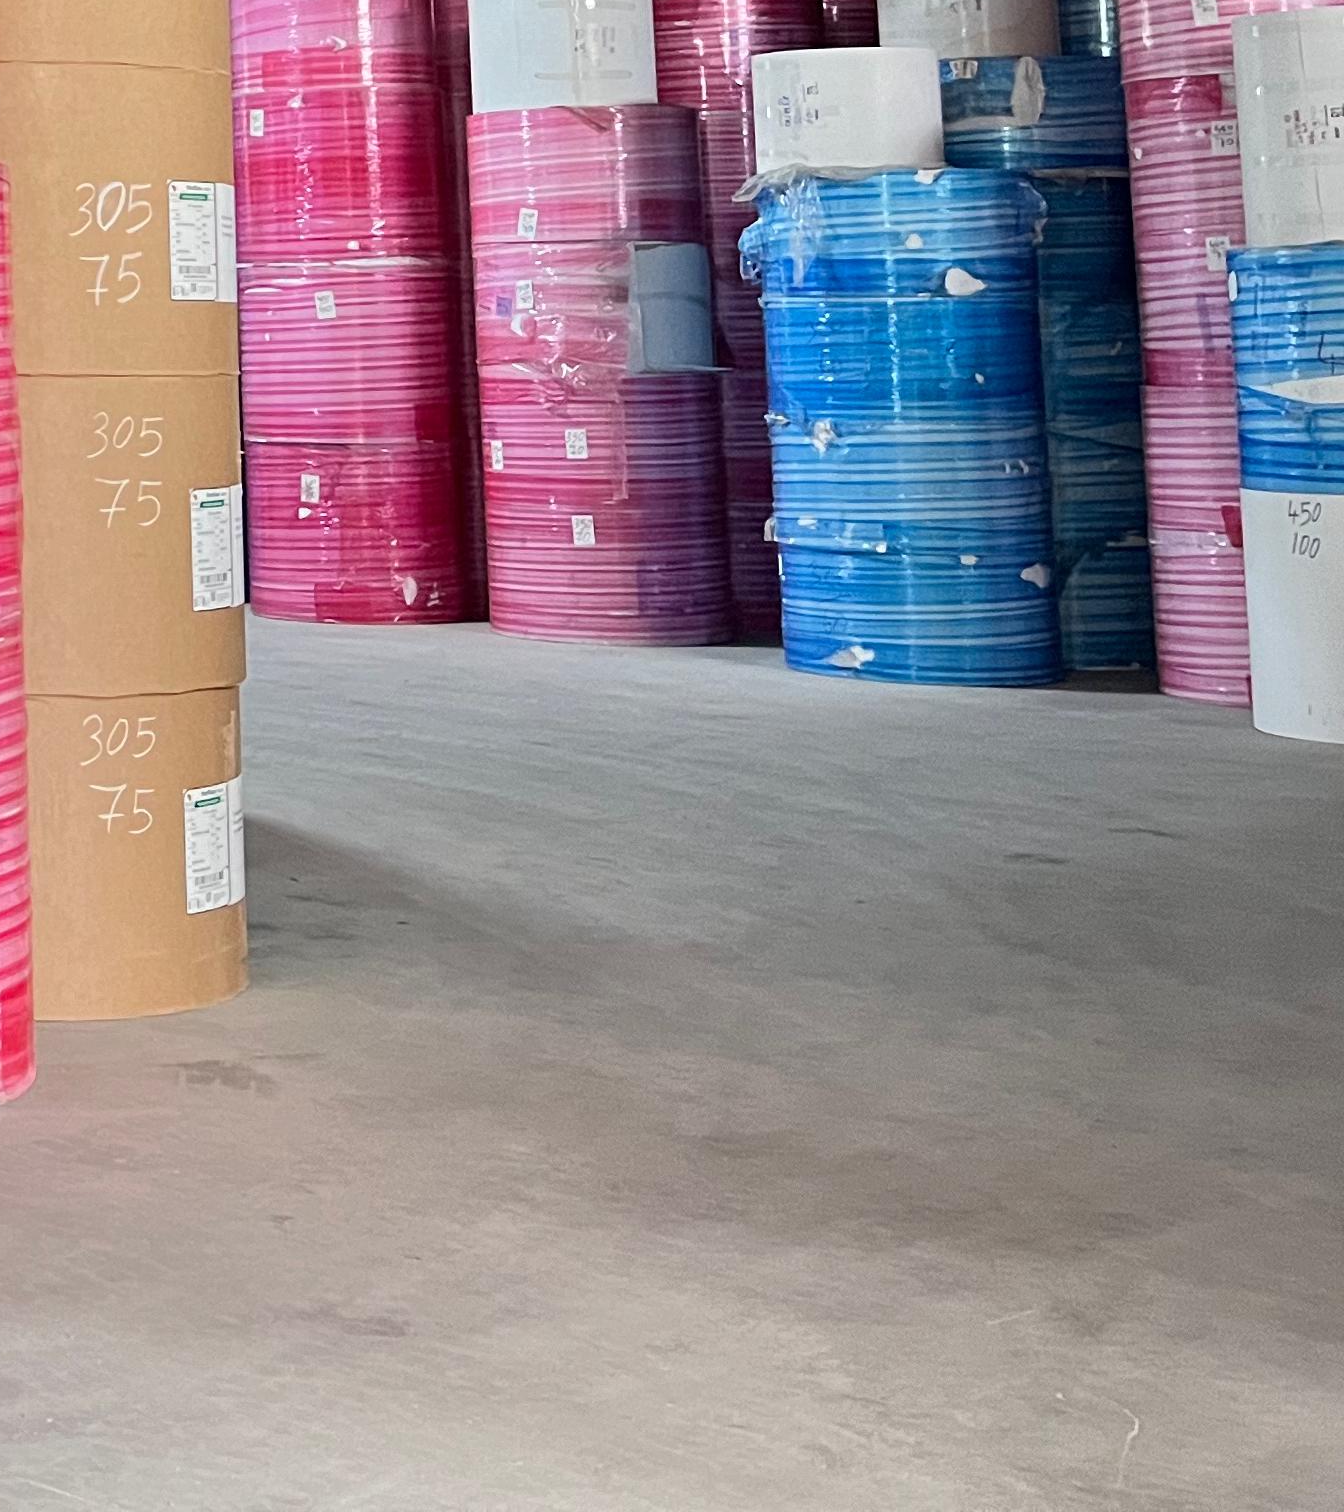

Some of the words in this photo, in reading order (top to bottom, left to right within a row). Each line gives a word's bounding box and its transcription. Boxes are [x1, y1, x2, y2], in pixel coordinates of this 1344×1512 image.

[69, 181, 153, 236] 305
[79, 251, 142, 306] 75
[86, 411, 164, 459] 305
[94, 477, 162, 529] 75
[1288, 500, 1322, 527] 450
[1292, 532, 1321, 559] 100
[80, 714, 157, 767] 305
[89, 783, 155, 835] 75
